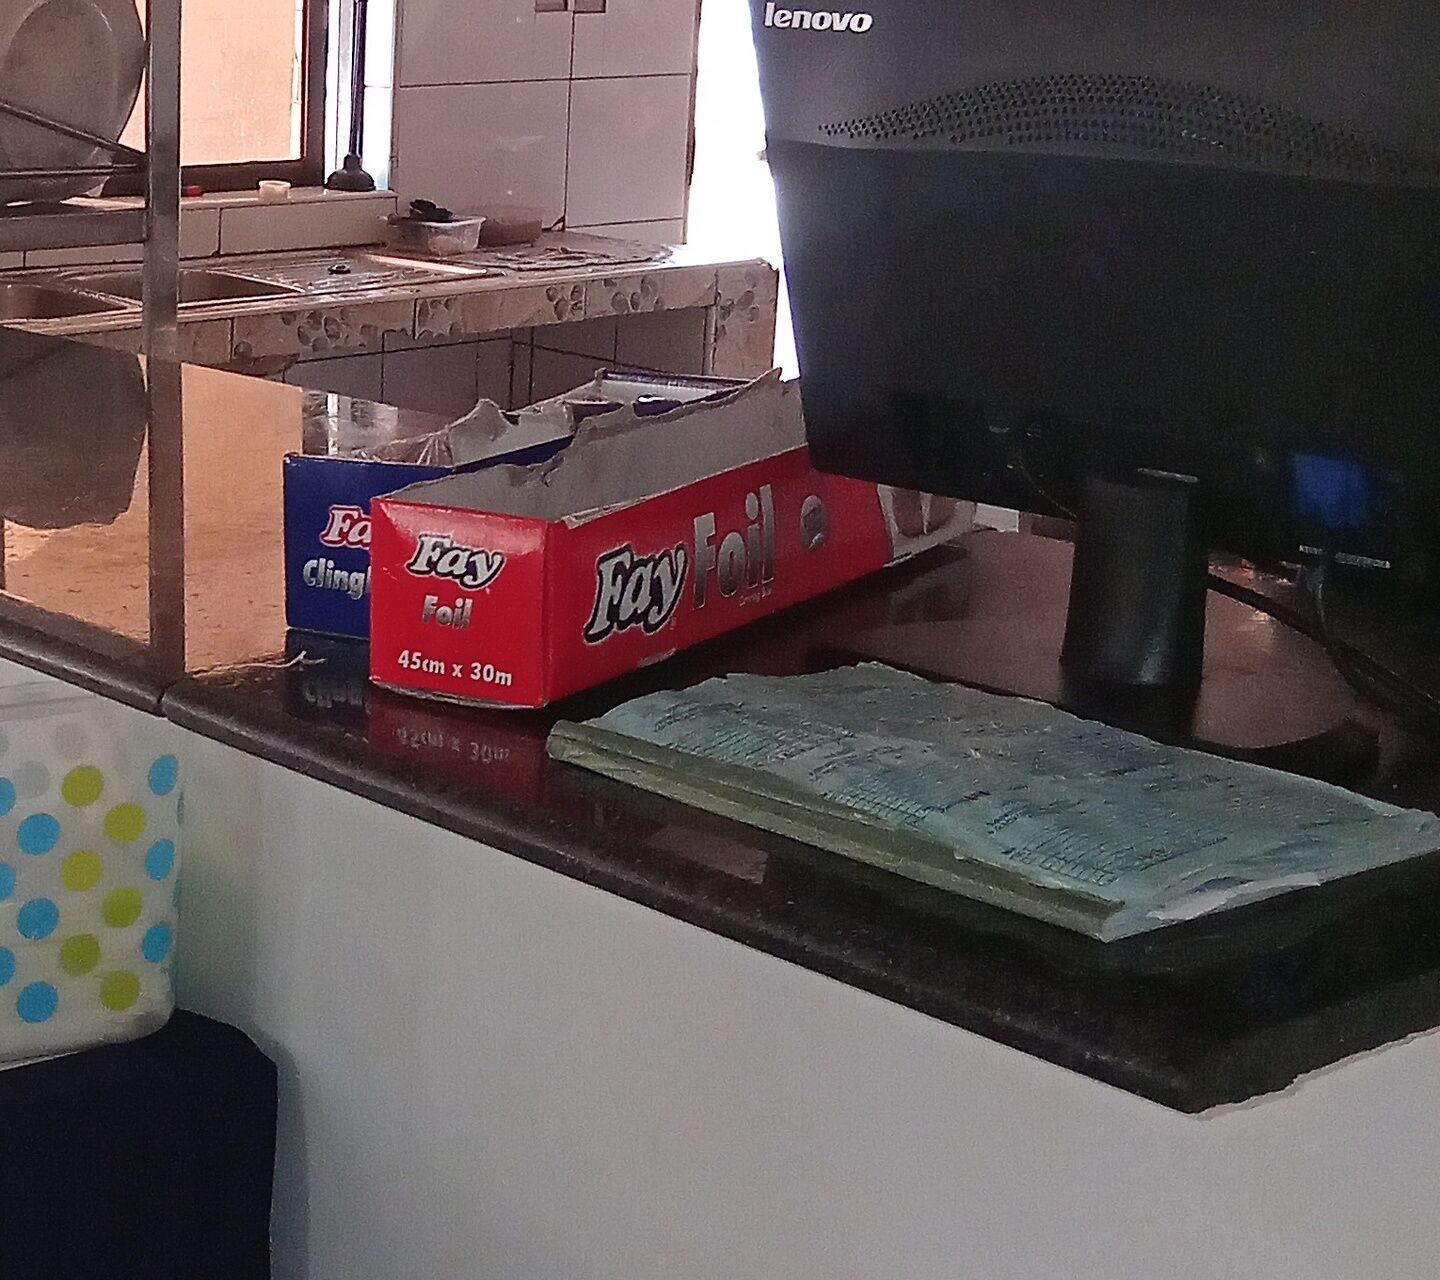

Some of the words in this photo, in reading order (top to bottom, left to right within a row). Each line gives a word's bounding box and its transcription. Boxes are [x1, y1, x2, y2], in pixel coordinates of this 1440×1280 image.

[764, 2, 873, 33] lenovo
[319, 504, 372, 550] Fa
[406, 532, 506, 591] Fay
[583, 542, 690, 646] Fay
[692, 483, 776, 612] Foil
[421, 594, 474, 631] Foil
[397, 649, 445, 676] 45cm
[451, 662, 464, 678] x
[469, 661, 513, 687] 30m
